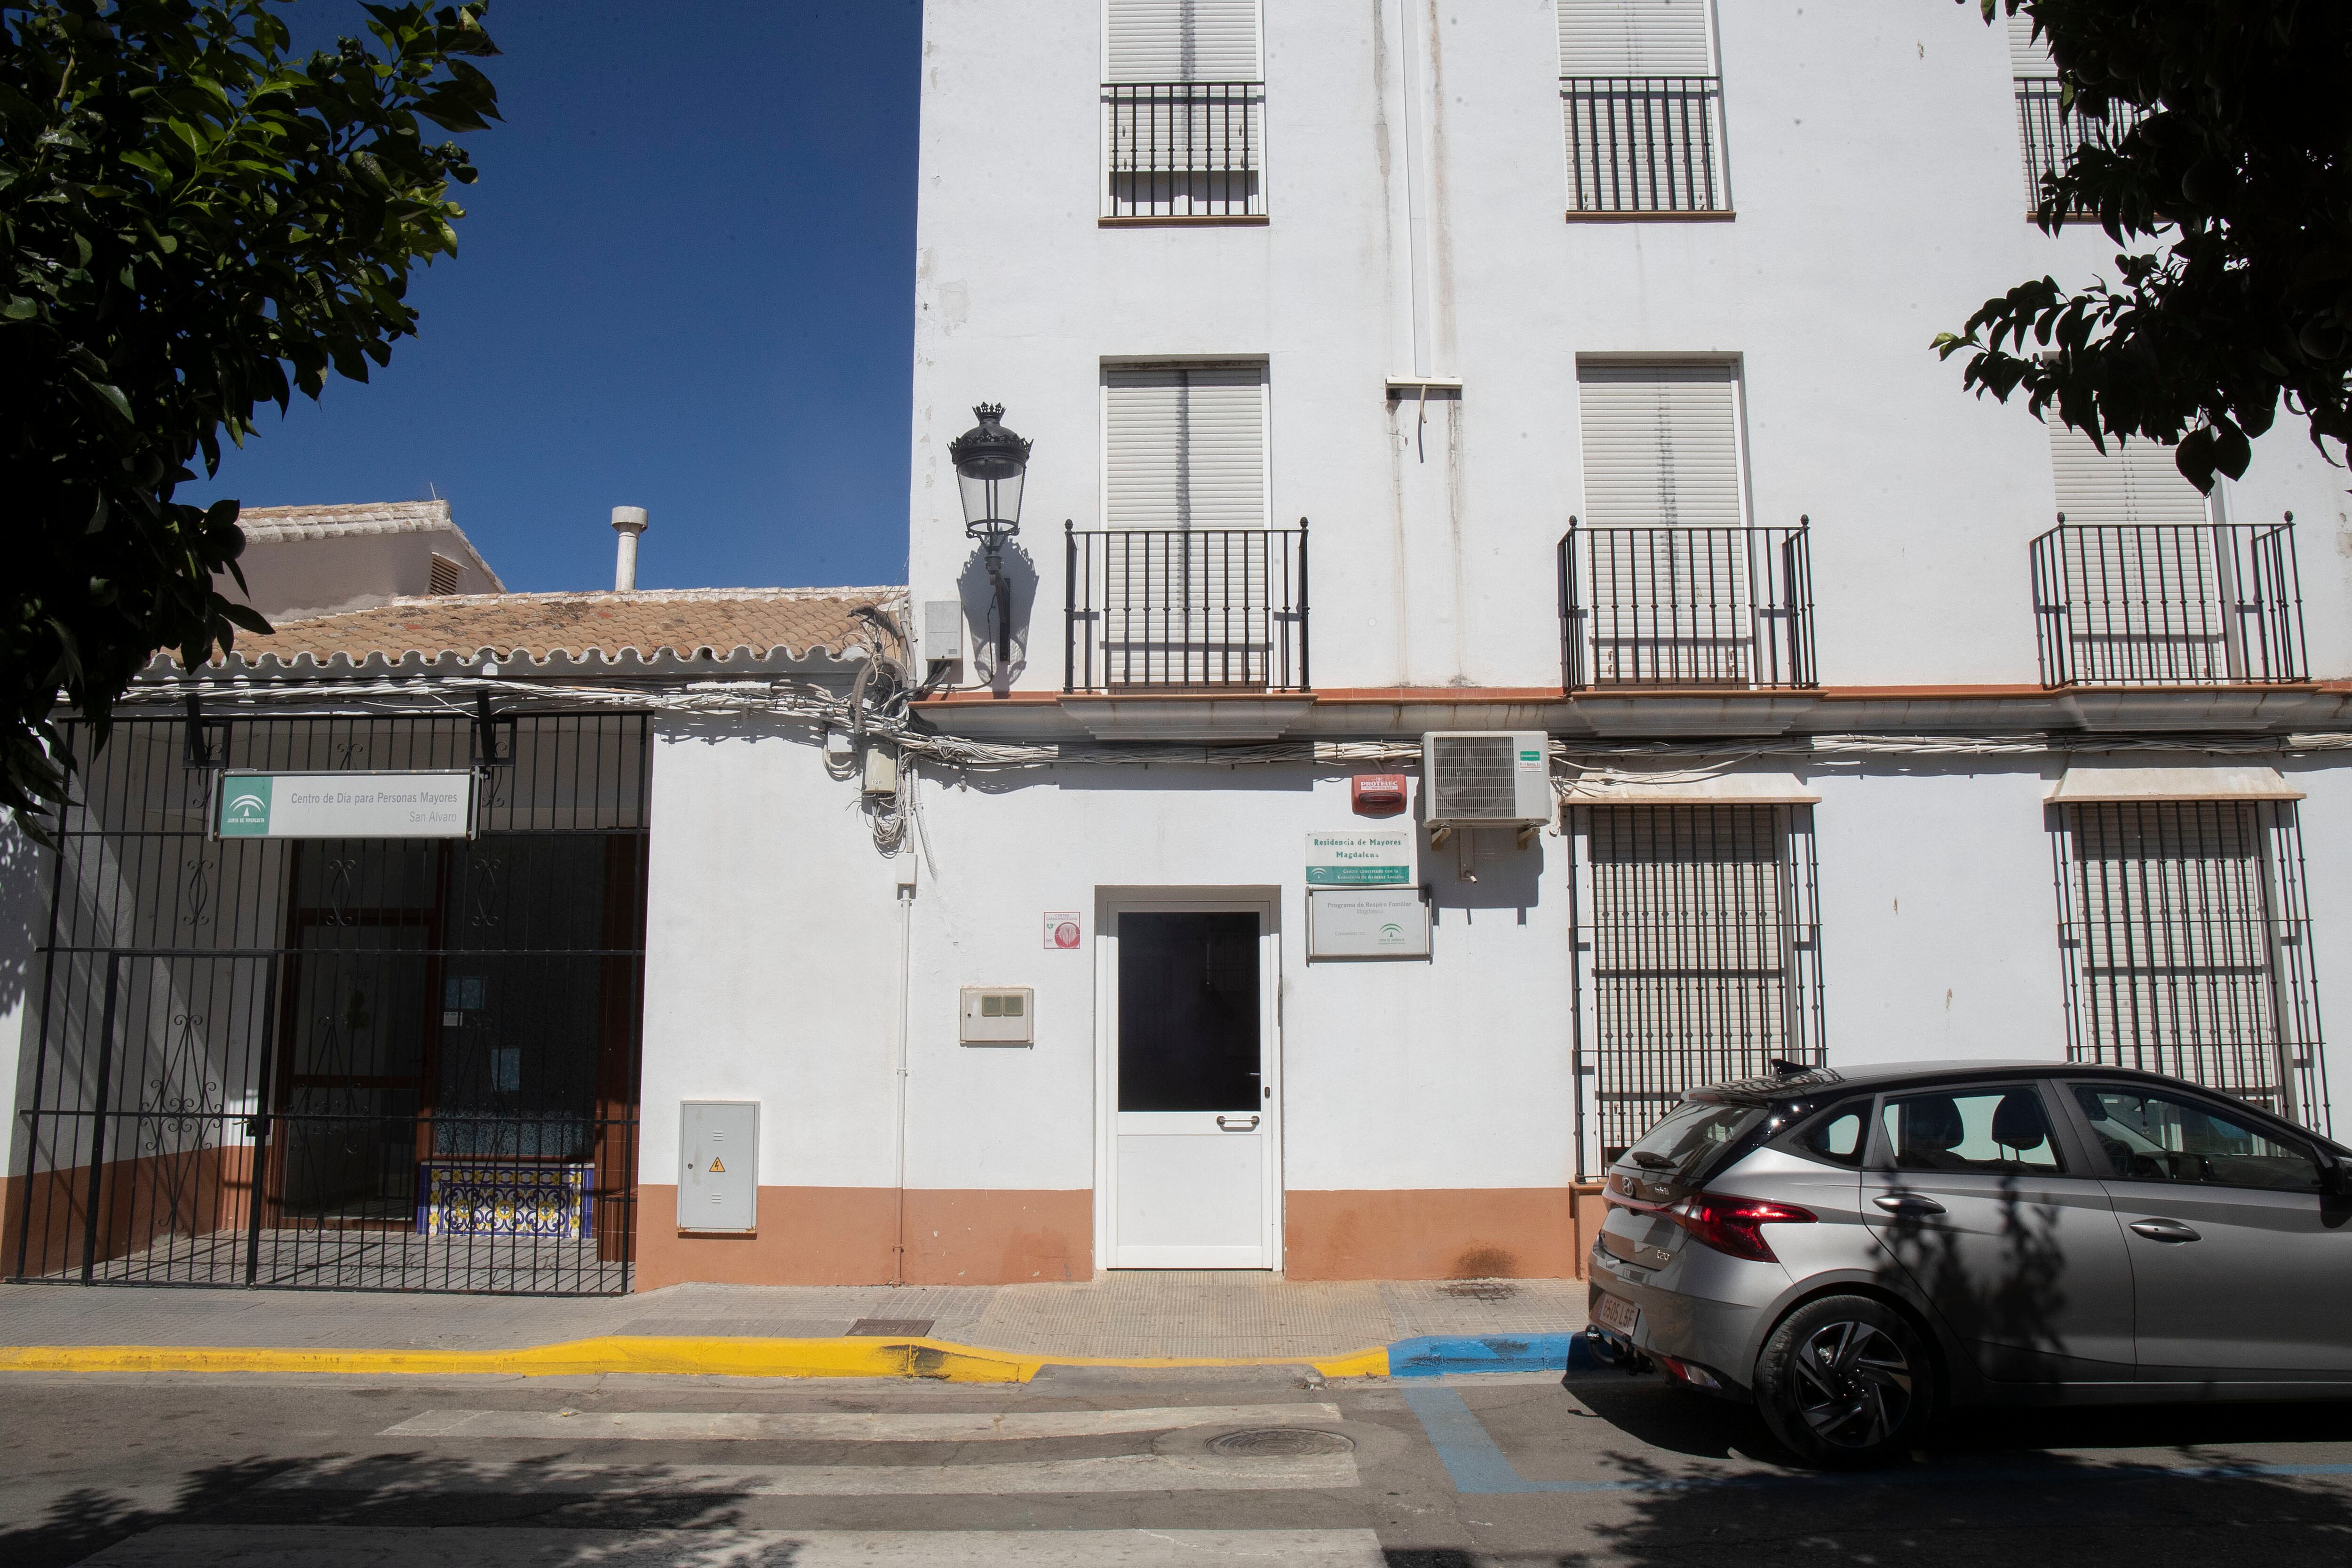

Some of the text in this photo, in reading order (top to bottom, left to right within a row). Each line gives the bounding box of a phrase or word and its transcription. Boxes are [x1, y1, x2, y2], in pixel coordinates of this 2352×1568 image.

[291, 792, 458, 805] Centro de Día para Personas Mayores
[409, 811, 457, 822] San Alvaro
[1619, 1305, 1635, 1328] LSF
